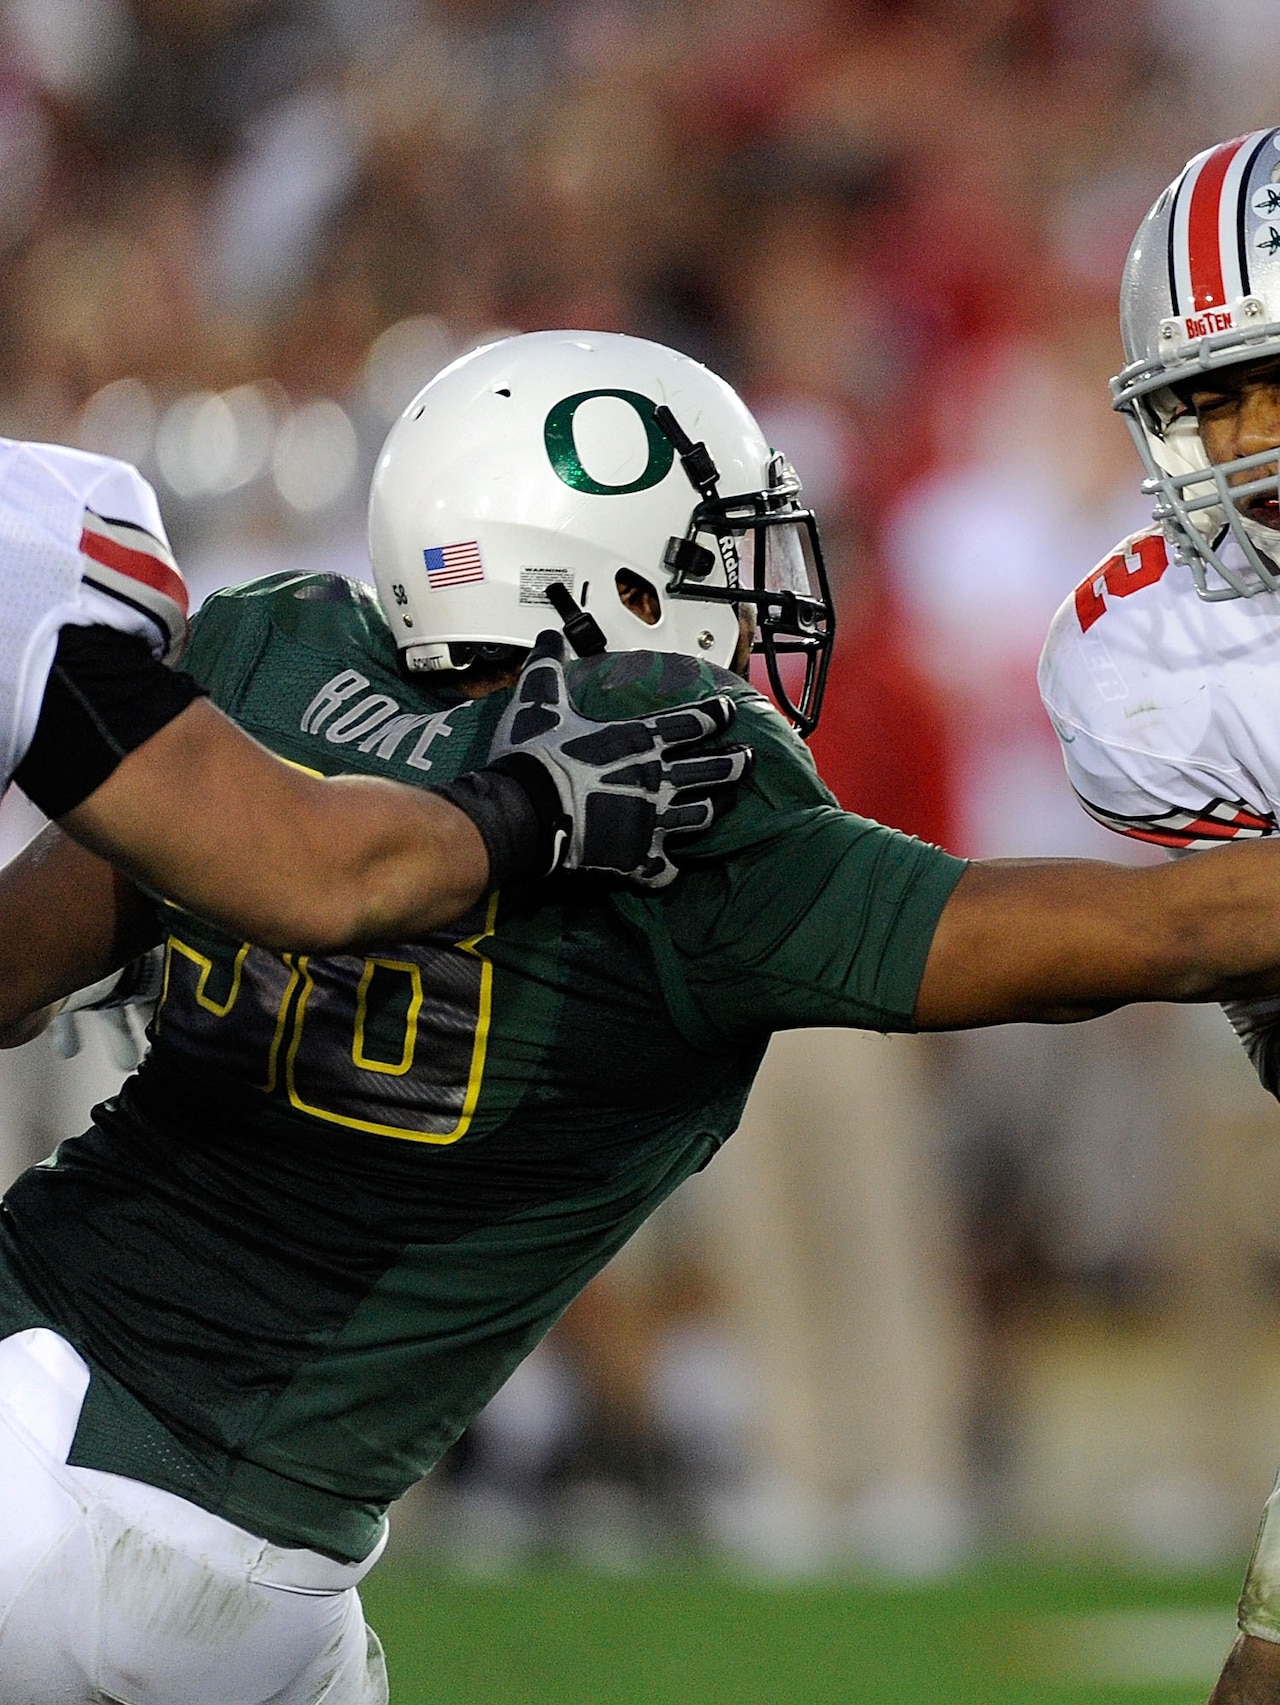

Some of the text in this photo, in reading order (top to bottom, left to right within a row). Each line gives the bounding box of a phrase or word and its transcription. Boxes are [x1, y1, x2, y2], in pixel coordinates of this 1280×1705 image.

[544, 388, 675, 496] O
[392, 584, 409, 606] 58
[1074, 535, 1169, 633] 2
